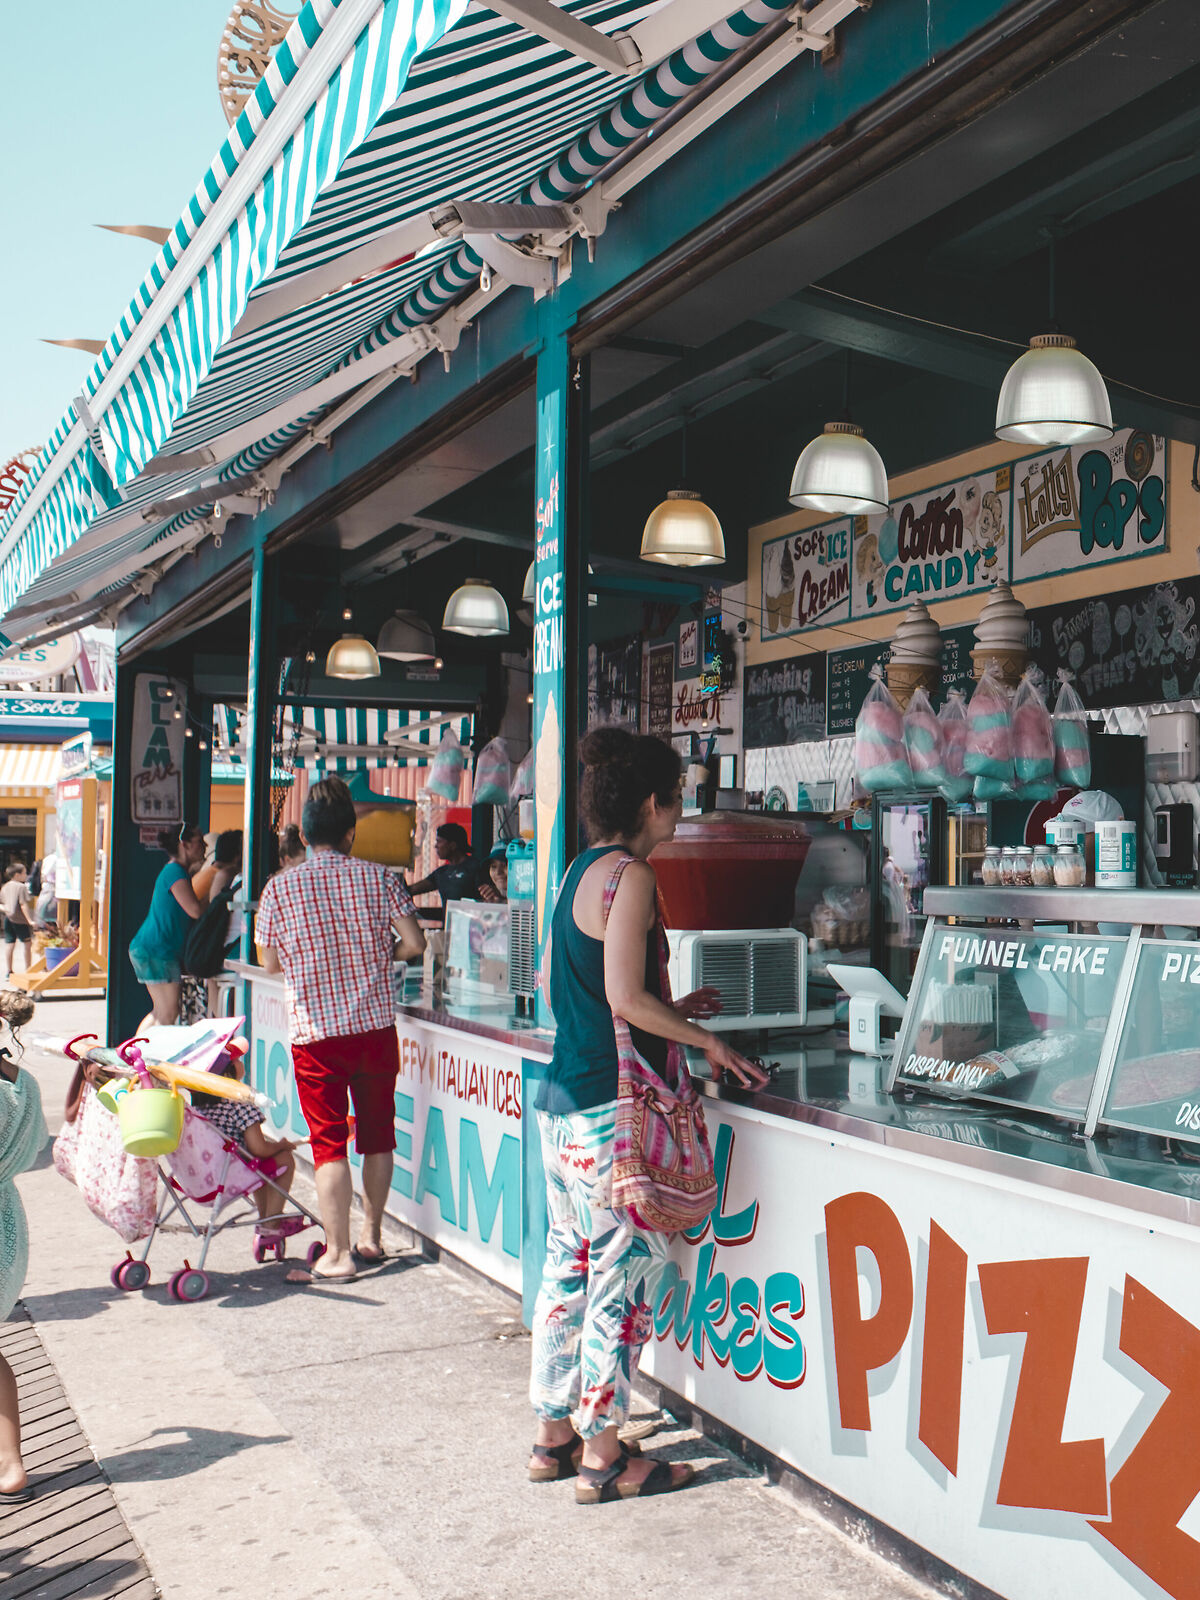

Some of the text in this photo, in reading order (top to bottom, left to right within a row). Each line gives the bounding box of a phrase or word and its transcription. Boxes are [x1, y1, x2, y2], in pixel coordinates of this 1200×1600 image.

[536, 471, 560, 543] Soft
[897, 488, 964, 563] Cotton
[1021, 458, 1072, 534] Lolly
[536, 537, 559, 563] serve
[794, 529, 848, 563] Soft ICE
[884, 549, 981, 603] CANDY
[535, 572, 563, 617] ICE
[798, 562, 849, 628] CREAM
[533, 613, 564, 675] CREAM
[11, 699, 80, 715] Sorbet
[938, 936, 1110, 976] FUNNEL CAKE
[256, 1038, 309, 1136] IC
[437, 1051, 489, 1107] ITALIAN
[493, 1068, 522, 1120] ICES
[904, 1054, 957, 1079] DISPLAY
[952, 1062, 989, 1089] ONLY
[653, 1242, 806, 1390] akes
